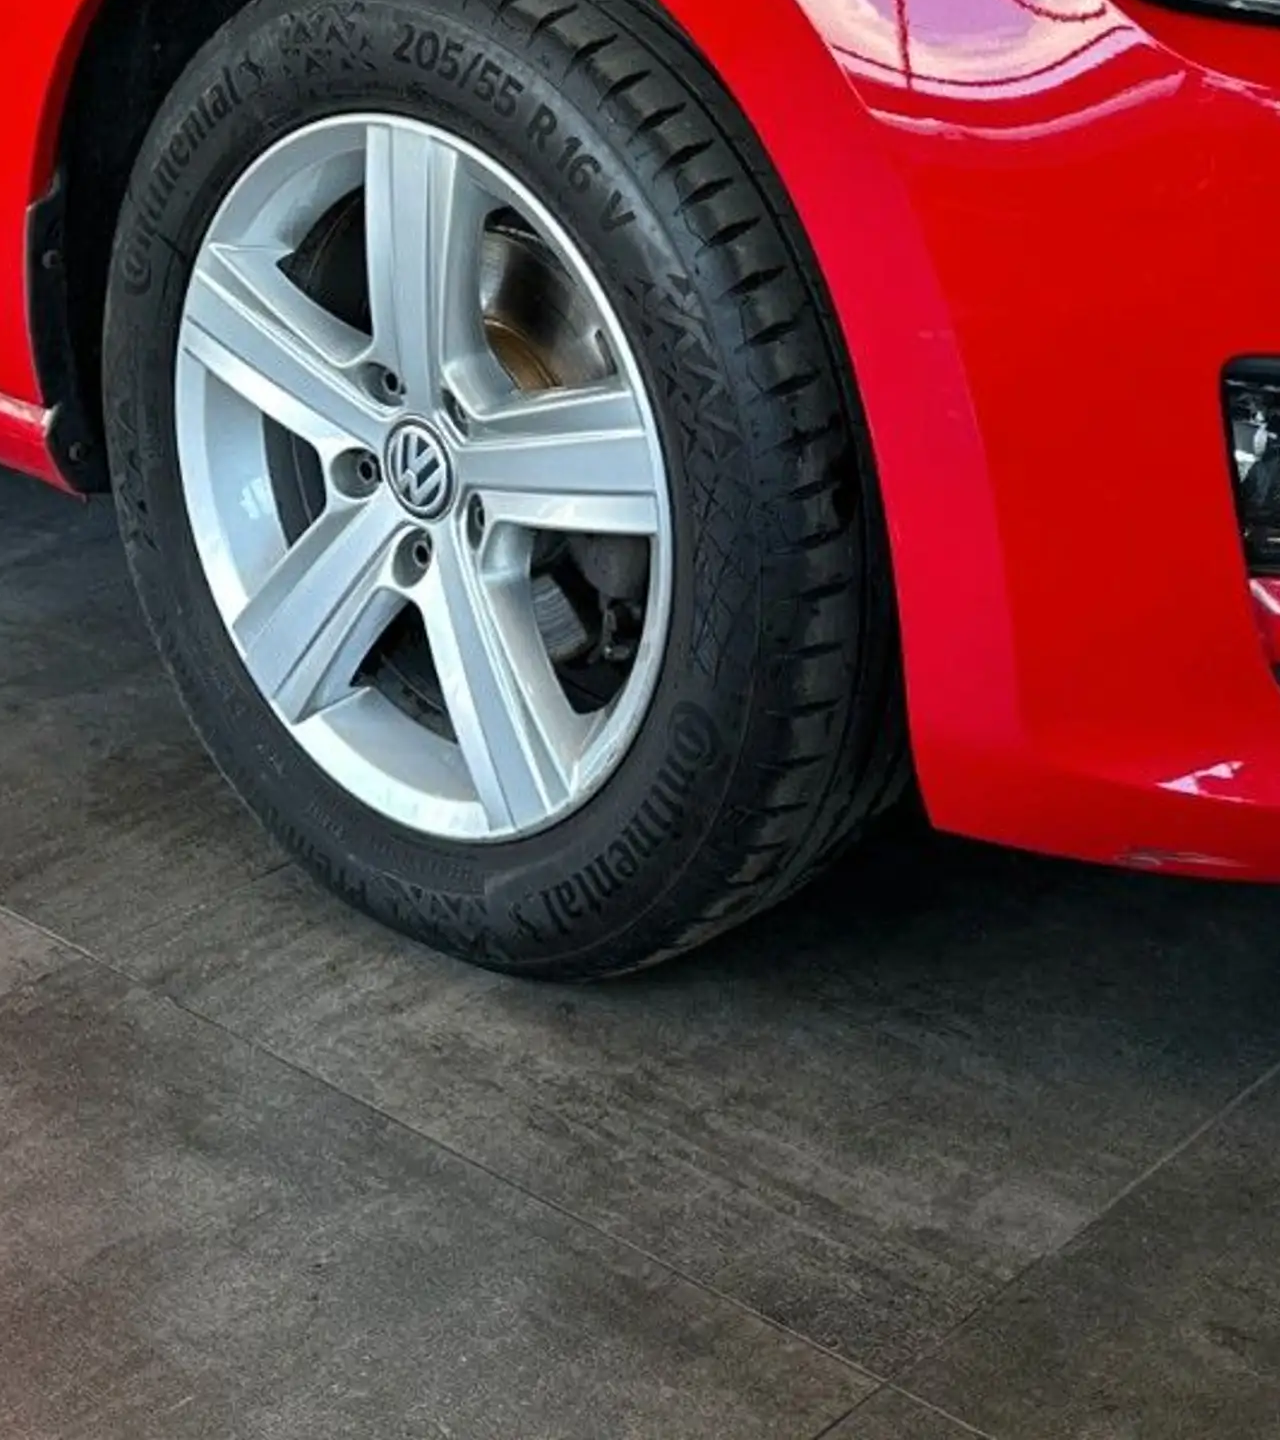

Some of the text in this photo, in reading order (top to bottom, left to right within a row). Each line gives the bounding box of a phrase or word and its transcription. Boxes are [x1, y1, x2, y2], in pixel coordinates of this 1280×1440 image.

[391, 23, 525, 119] 205/55
[527, 104, 560, 153] R
[555, 135, 603, 196] 16
[540, 700, 723, 935] Continental
